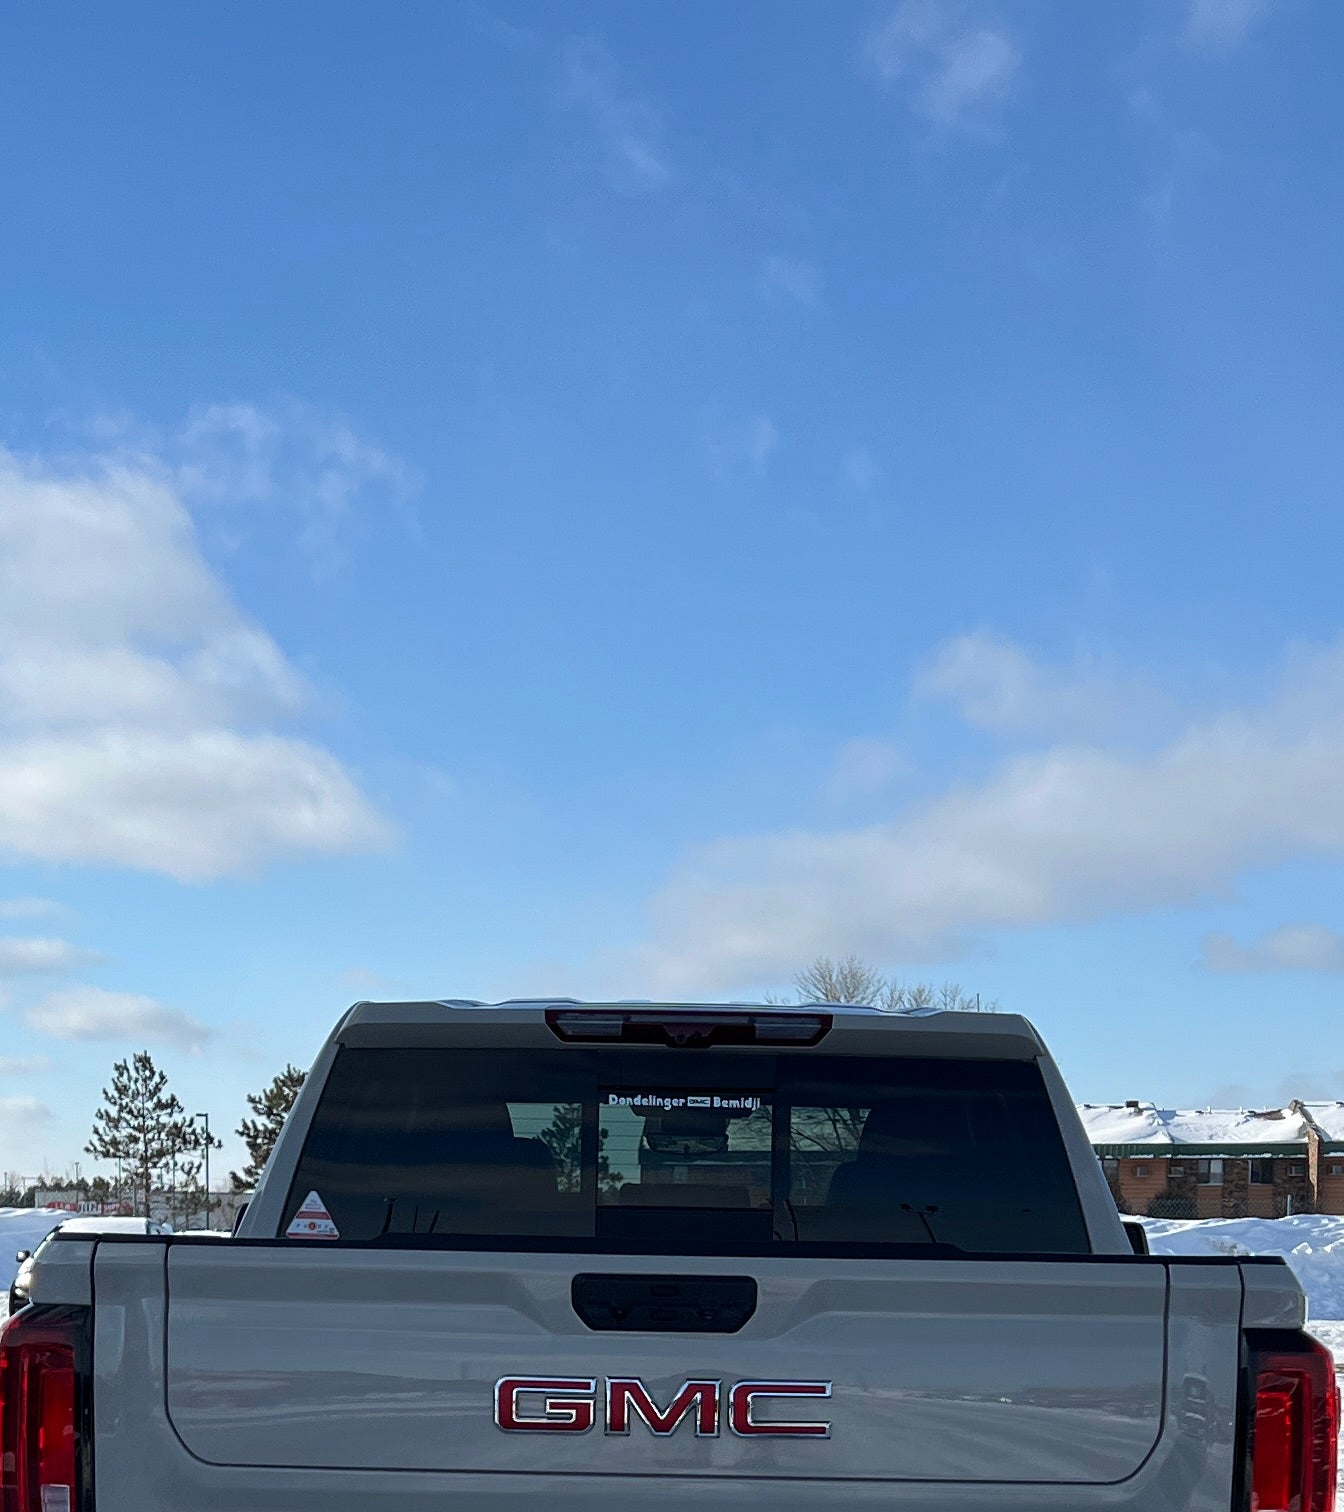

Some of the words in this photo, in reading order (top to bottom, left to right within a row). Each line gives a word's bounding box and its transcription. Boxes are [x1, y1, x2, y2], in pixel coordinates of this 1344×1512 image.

[608, 1094, 685, 1110] Dondelinger
[713, 1096, 760, 1111] Bemidji
[494, 1375, 832, 1438] GMC
